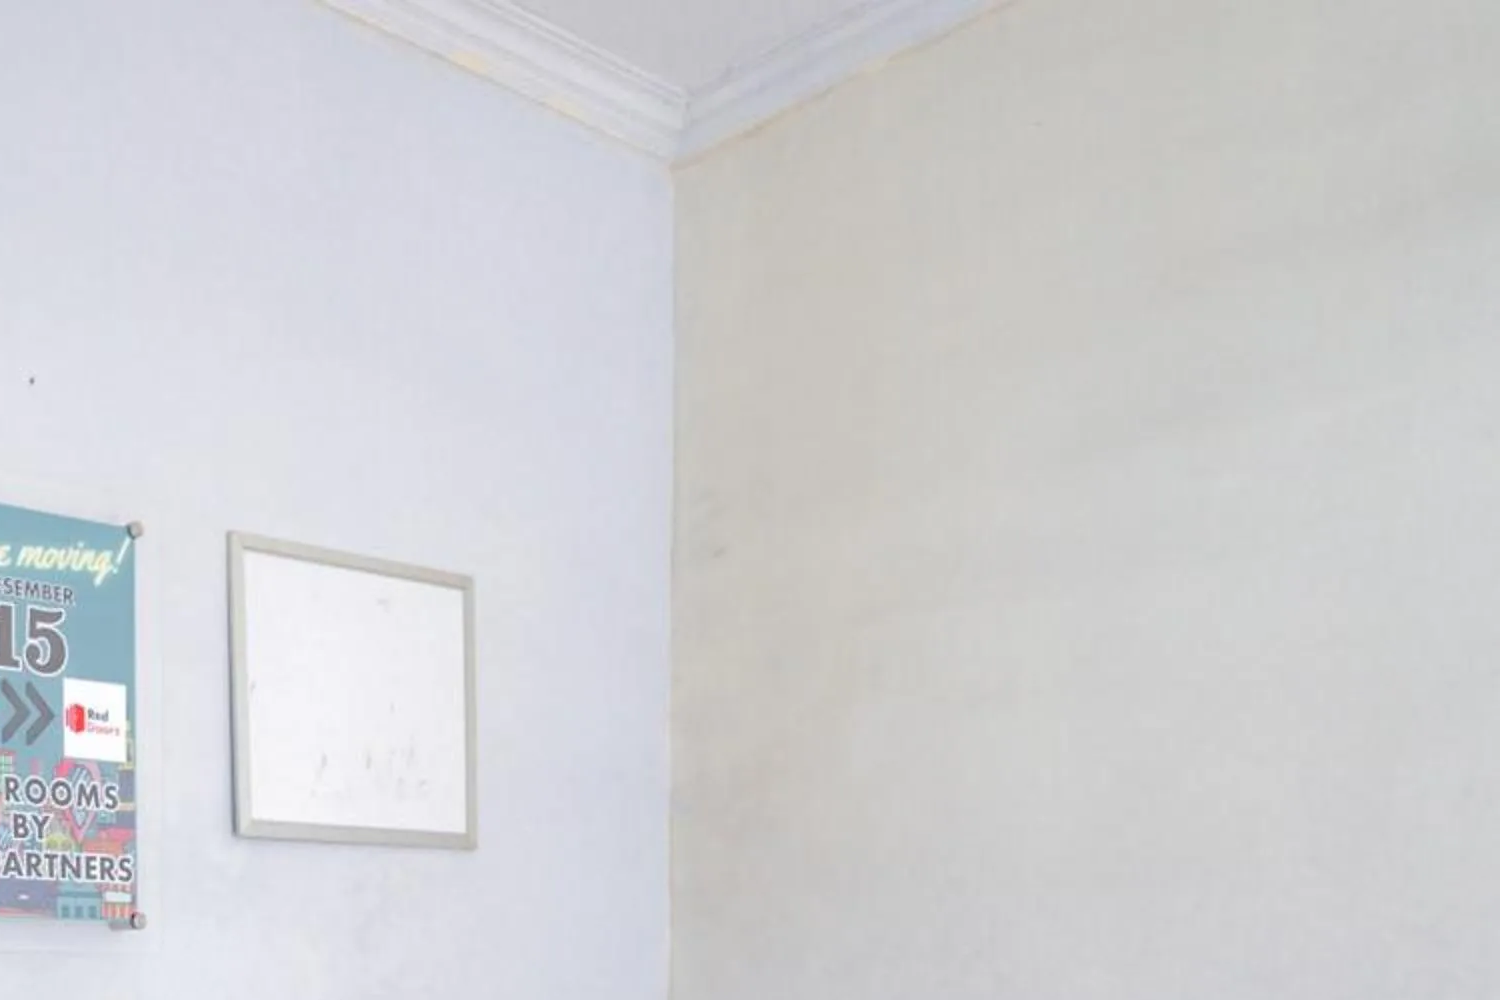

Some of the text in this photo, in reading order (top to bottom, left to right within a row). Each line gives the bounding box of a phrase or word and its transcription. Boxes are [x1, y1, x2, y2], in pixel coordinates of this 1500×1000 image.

[16, 535, 132, 587] moving!
[87, 707, 109, 722] Red
[4, 776, 119, 810] ROOMS
[12, 813, 51, 840] BY
